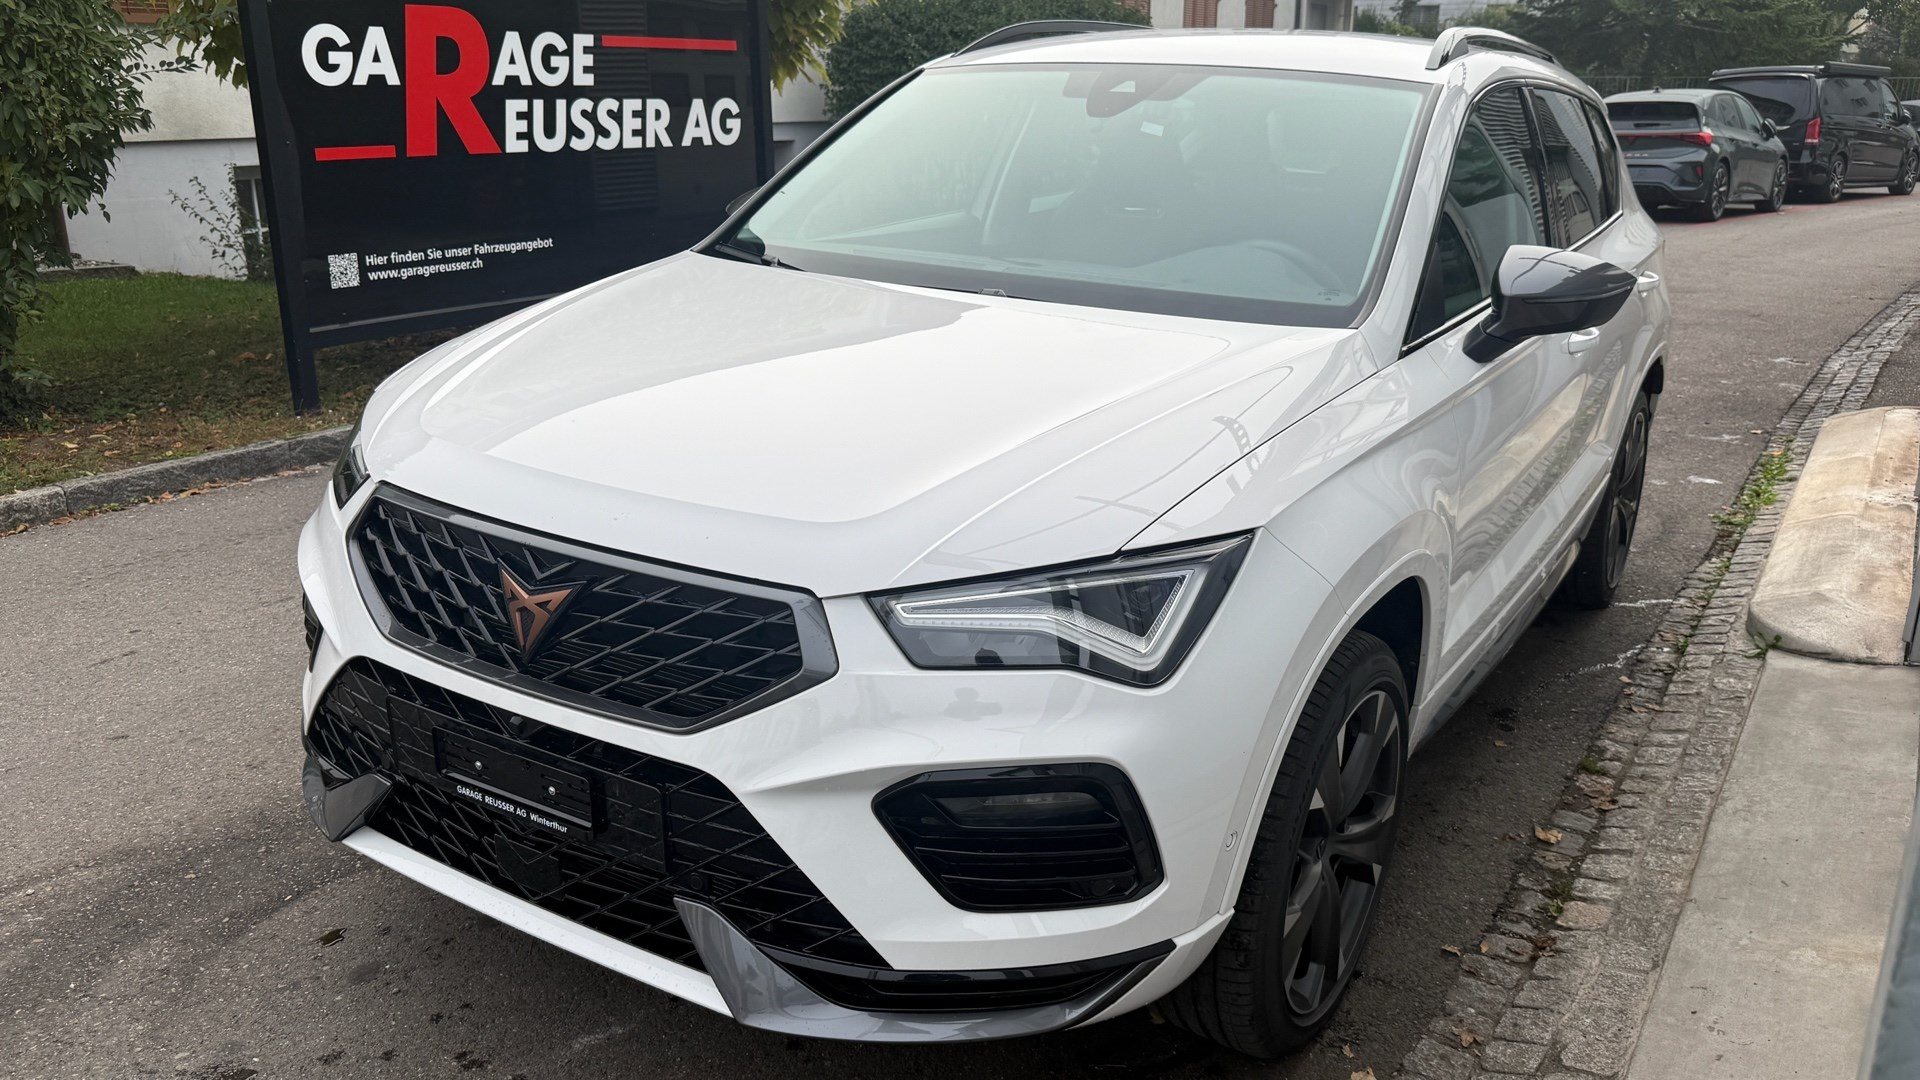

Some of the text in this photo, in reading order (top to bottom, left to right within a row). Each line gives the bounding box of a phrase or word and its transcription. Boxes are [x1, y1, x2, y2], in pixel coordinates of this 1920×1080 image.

[302, 4, 595, 157] GARAGE
[682, 97, 742, 147] AG
[366, 238, 554, 267] Hier finden Sie unser Fahrzeugangebot
[368, 258, 483, 281] www.garagereusser.ch
[456, 785, 568, 832] GARAGE REUSSER AG Winterthur
